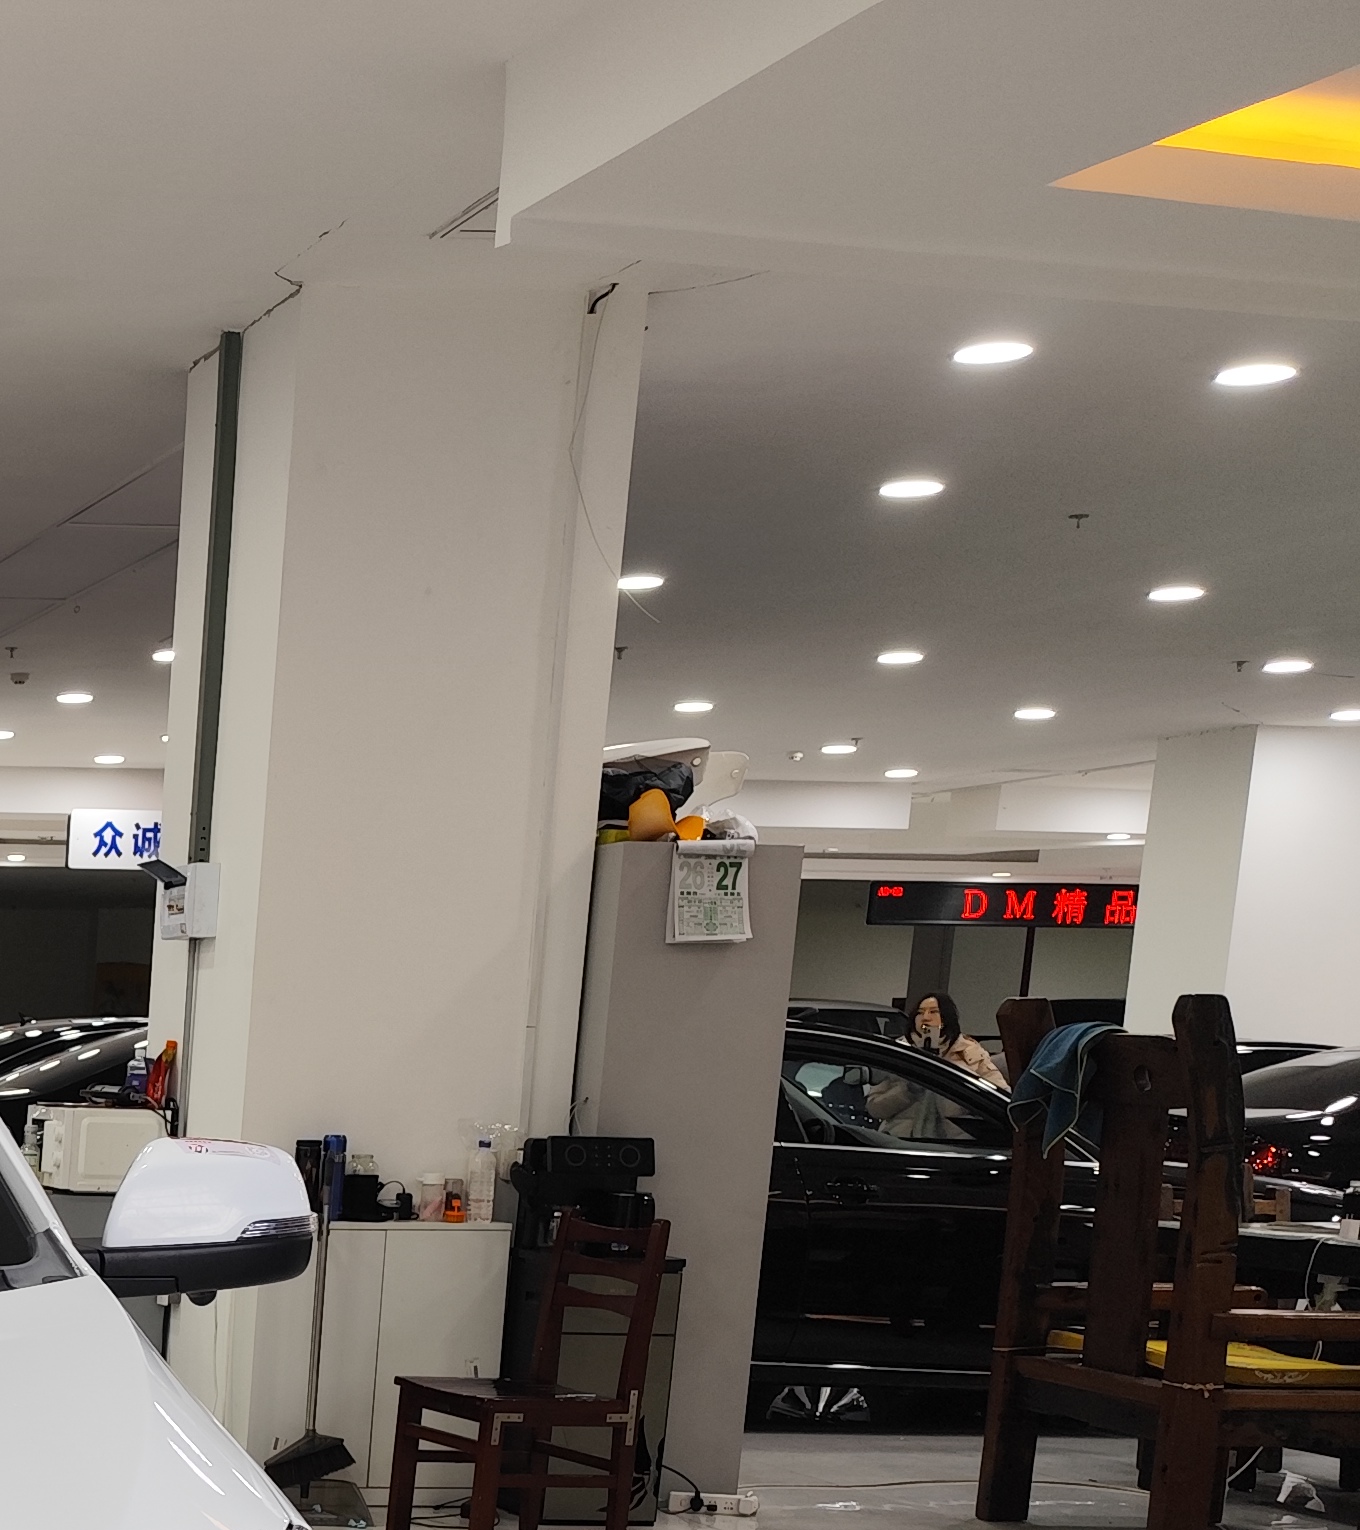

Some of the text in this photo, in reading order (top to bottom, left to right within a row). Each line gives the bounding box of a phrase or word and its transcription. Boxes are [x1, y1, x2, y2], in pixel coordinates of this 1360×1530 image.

[91, 821, 161, 859] 众诚
[678, 860, 743, 891] 26 27
